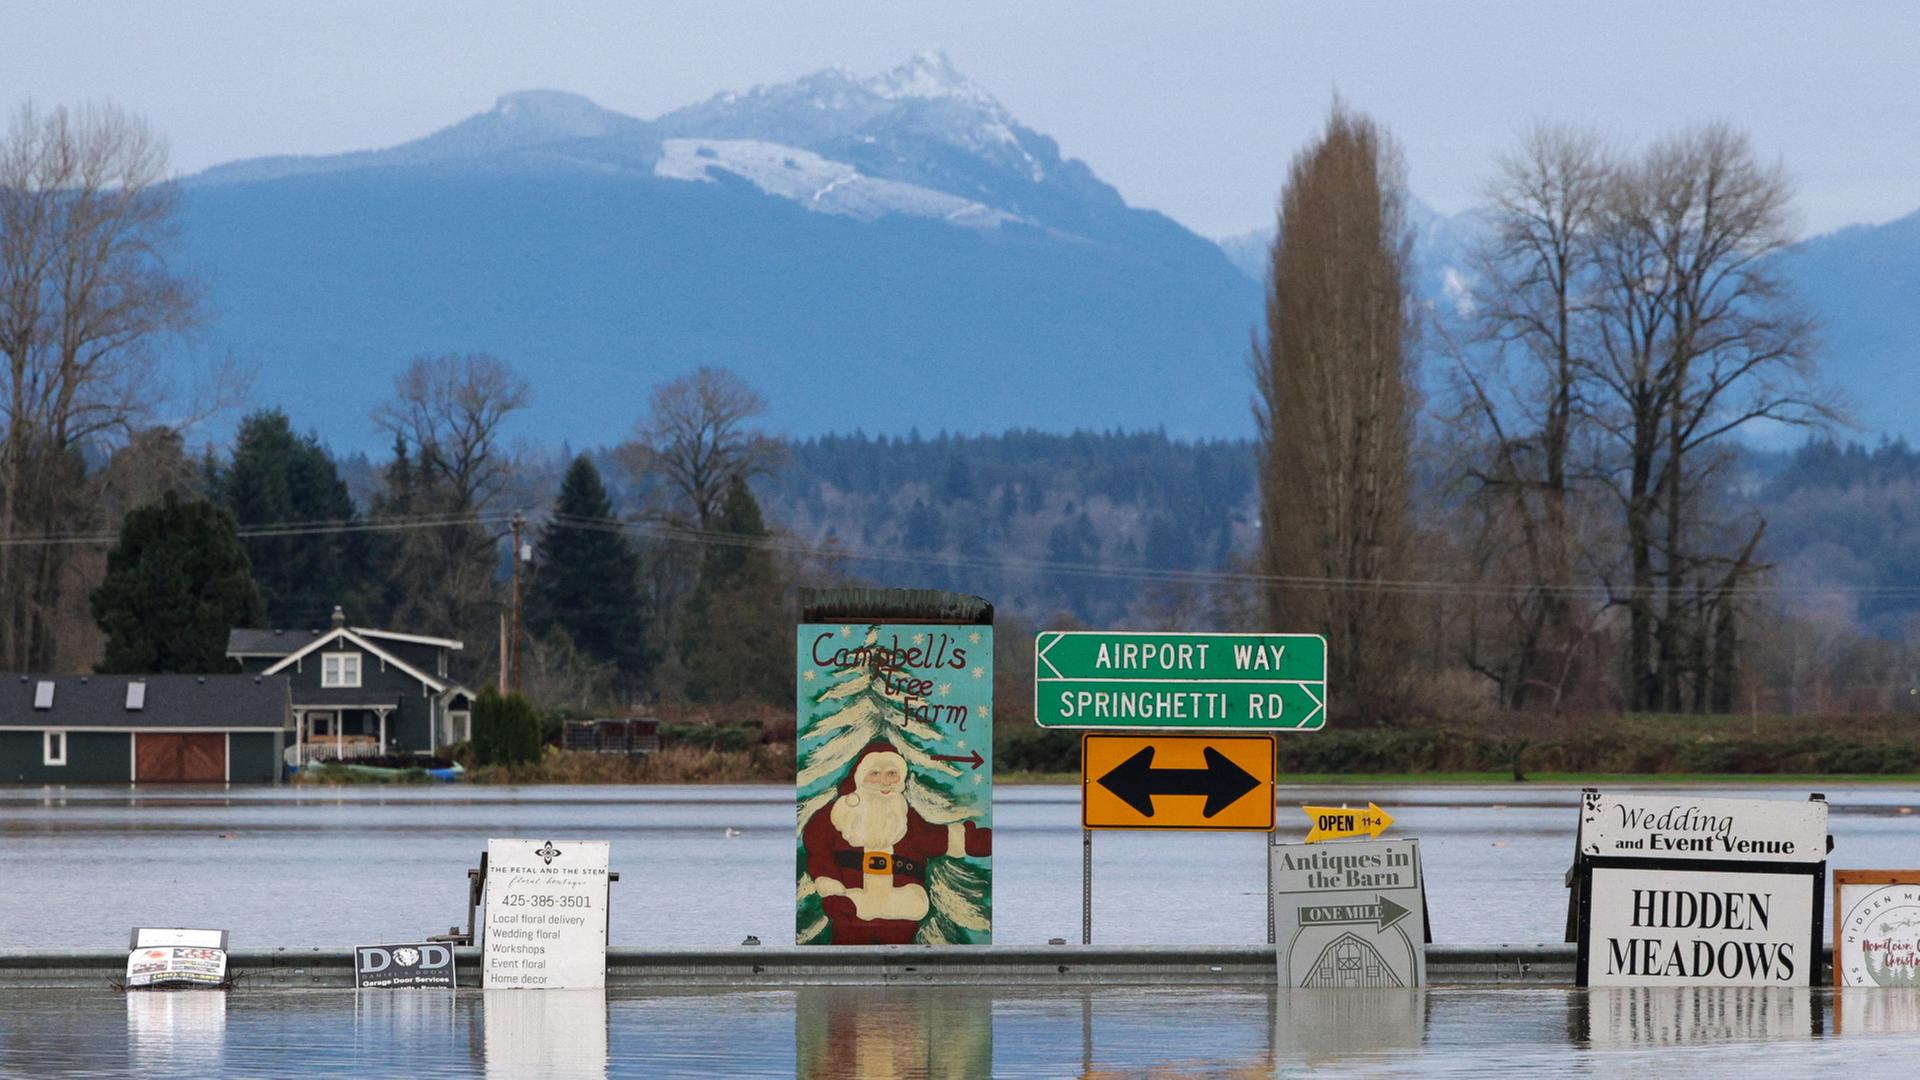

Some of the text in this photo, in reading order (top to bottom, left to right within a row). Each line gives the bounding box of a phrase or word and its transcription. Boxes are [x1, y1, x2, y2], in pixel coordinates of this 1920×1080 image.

[812, 632, 966, 680] Campbell's
[1095, 642, 1286, 670] AIRPORT WAY
[881, 668, 934, 696] Tree
[902, 696, 968, 732] Farm
[1060, 691, 1284, 718] SPRINGHETTI RD
[1318, 815, 1382, 832] OPEN 11-4
[1614, 803, 1734, 840] Wedding
[1615, 834, 1794, 854] and Event Venue
[1280, 848, 1409, 874] Antiques in
[1308, 870, 1400, 888] the Barn
[502, 894, 592, 908] 425-385-3501
[1631, 889, 1772, 931] HIDDEN
[492, 914, 586, 926] Local floral delivery
[1309, 906, 1384, 920] ONE MILE
[1848, 896, 1892, 943] HIDDEN
[492, 929, 561, 941] Wedding floral
[492, 944, 545, 956] Workshops
[1606, 938, 1794, 981] MEADOWS
[491, 958, 546, 968] Event floral
[491, 974, 548, 984] Home decor
